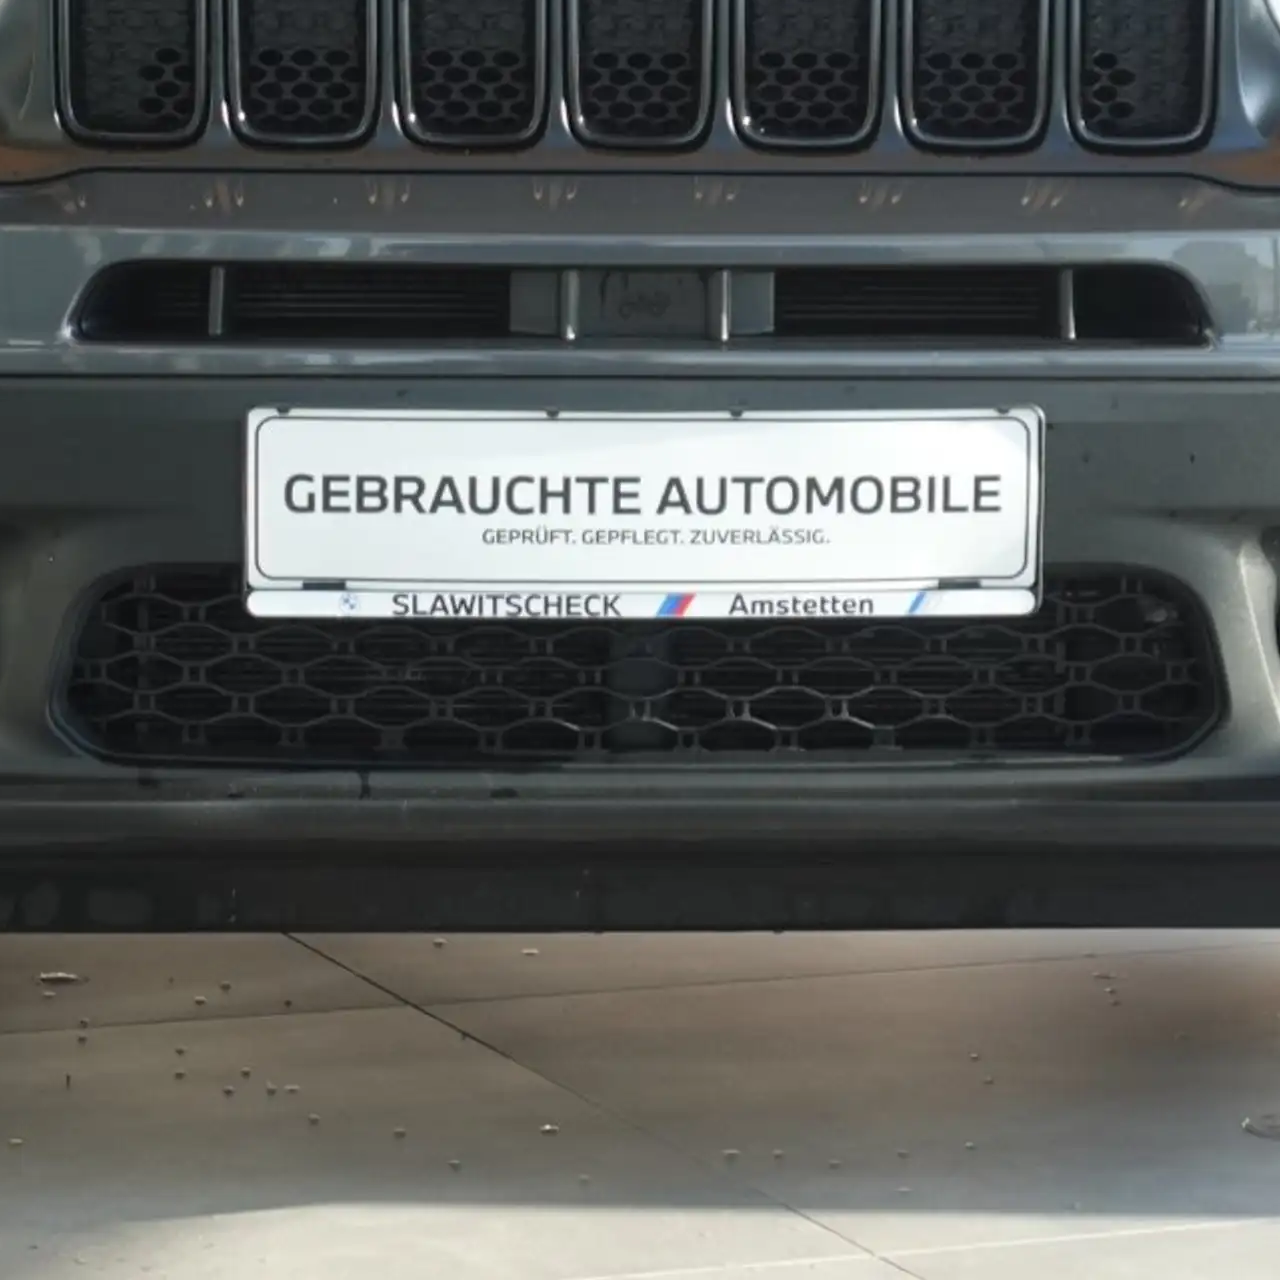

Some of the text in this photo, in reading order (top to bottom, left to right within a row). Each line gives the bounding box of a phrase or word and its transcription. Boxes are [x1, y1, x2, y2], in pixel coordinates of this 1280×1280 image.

[283, 473, 1002, 516] GEBRAUCHTE AUTOMOBILE
[481, 526, 831, 547] GEPRÜFT. GEPFLEGT. ZUVERLÄSSIG.
[391, 592, 876, 618] SLAWITSCHECK Amstetten
